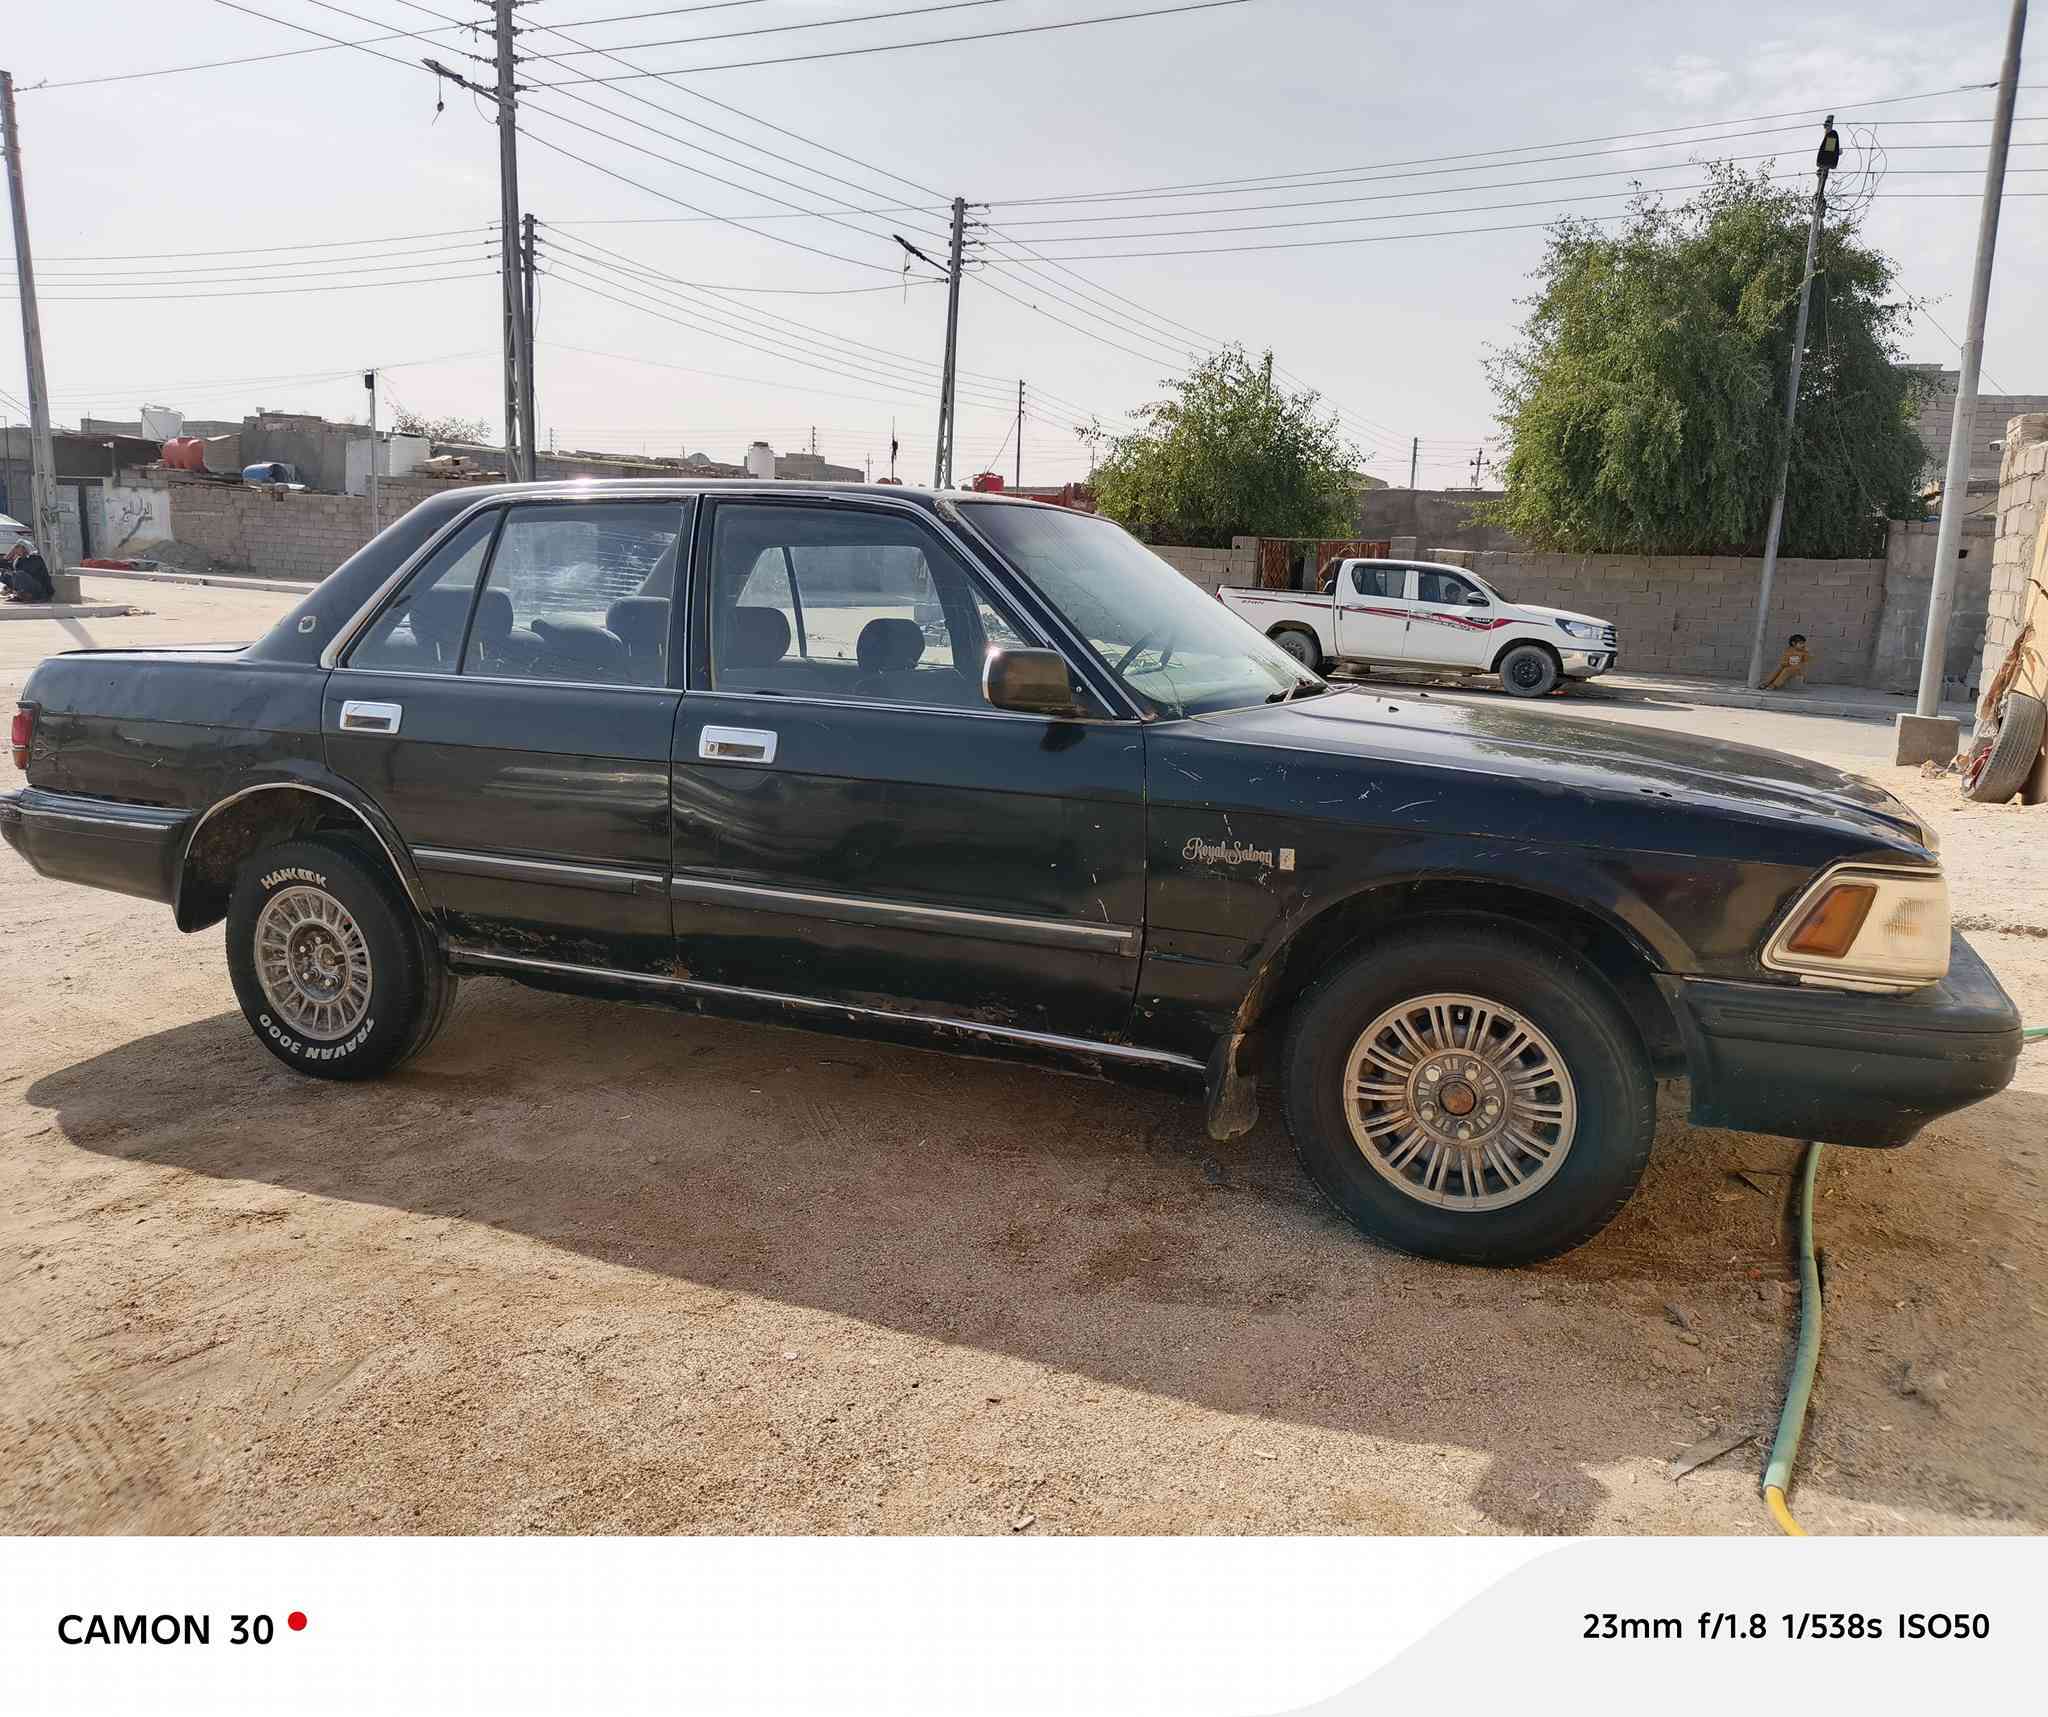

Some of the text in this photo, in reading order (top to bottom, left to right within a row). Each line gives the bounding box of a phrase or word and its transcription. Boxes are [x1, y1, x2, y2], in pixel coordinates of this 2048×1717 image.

[1182, 837, 1227, 865] Royal
[1226, 840, 1273, 867] Saloon
[258, 1013, 303, 1055] 3000
